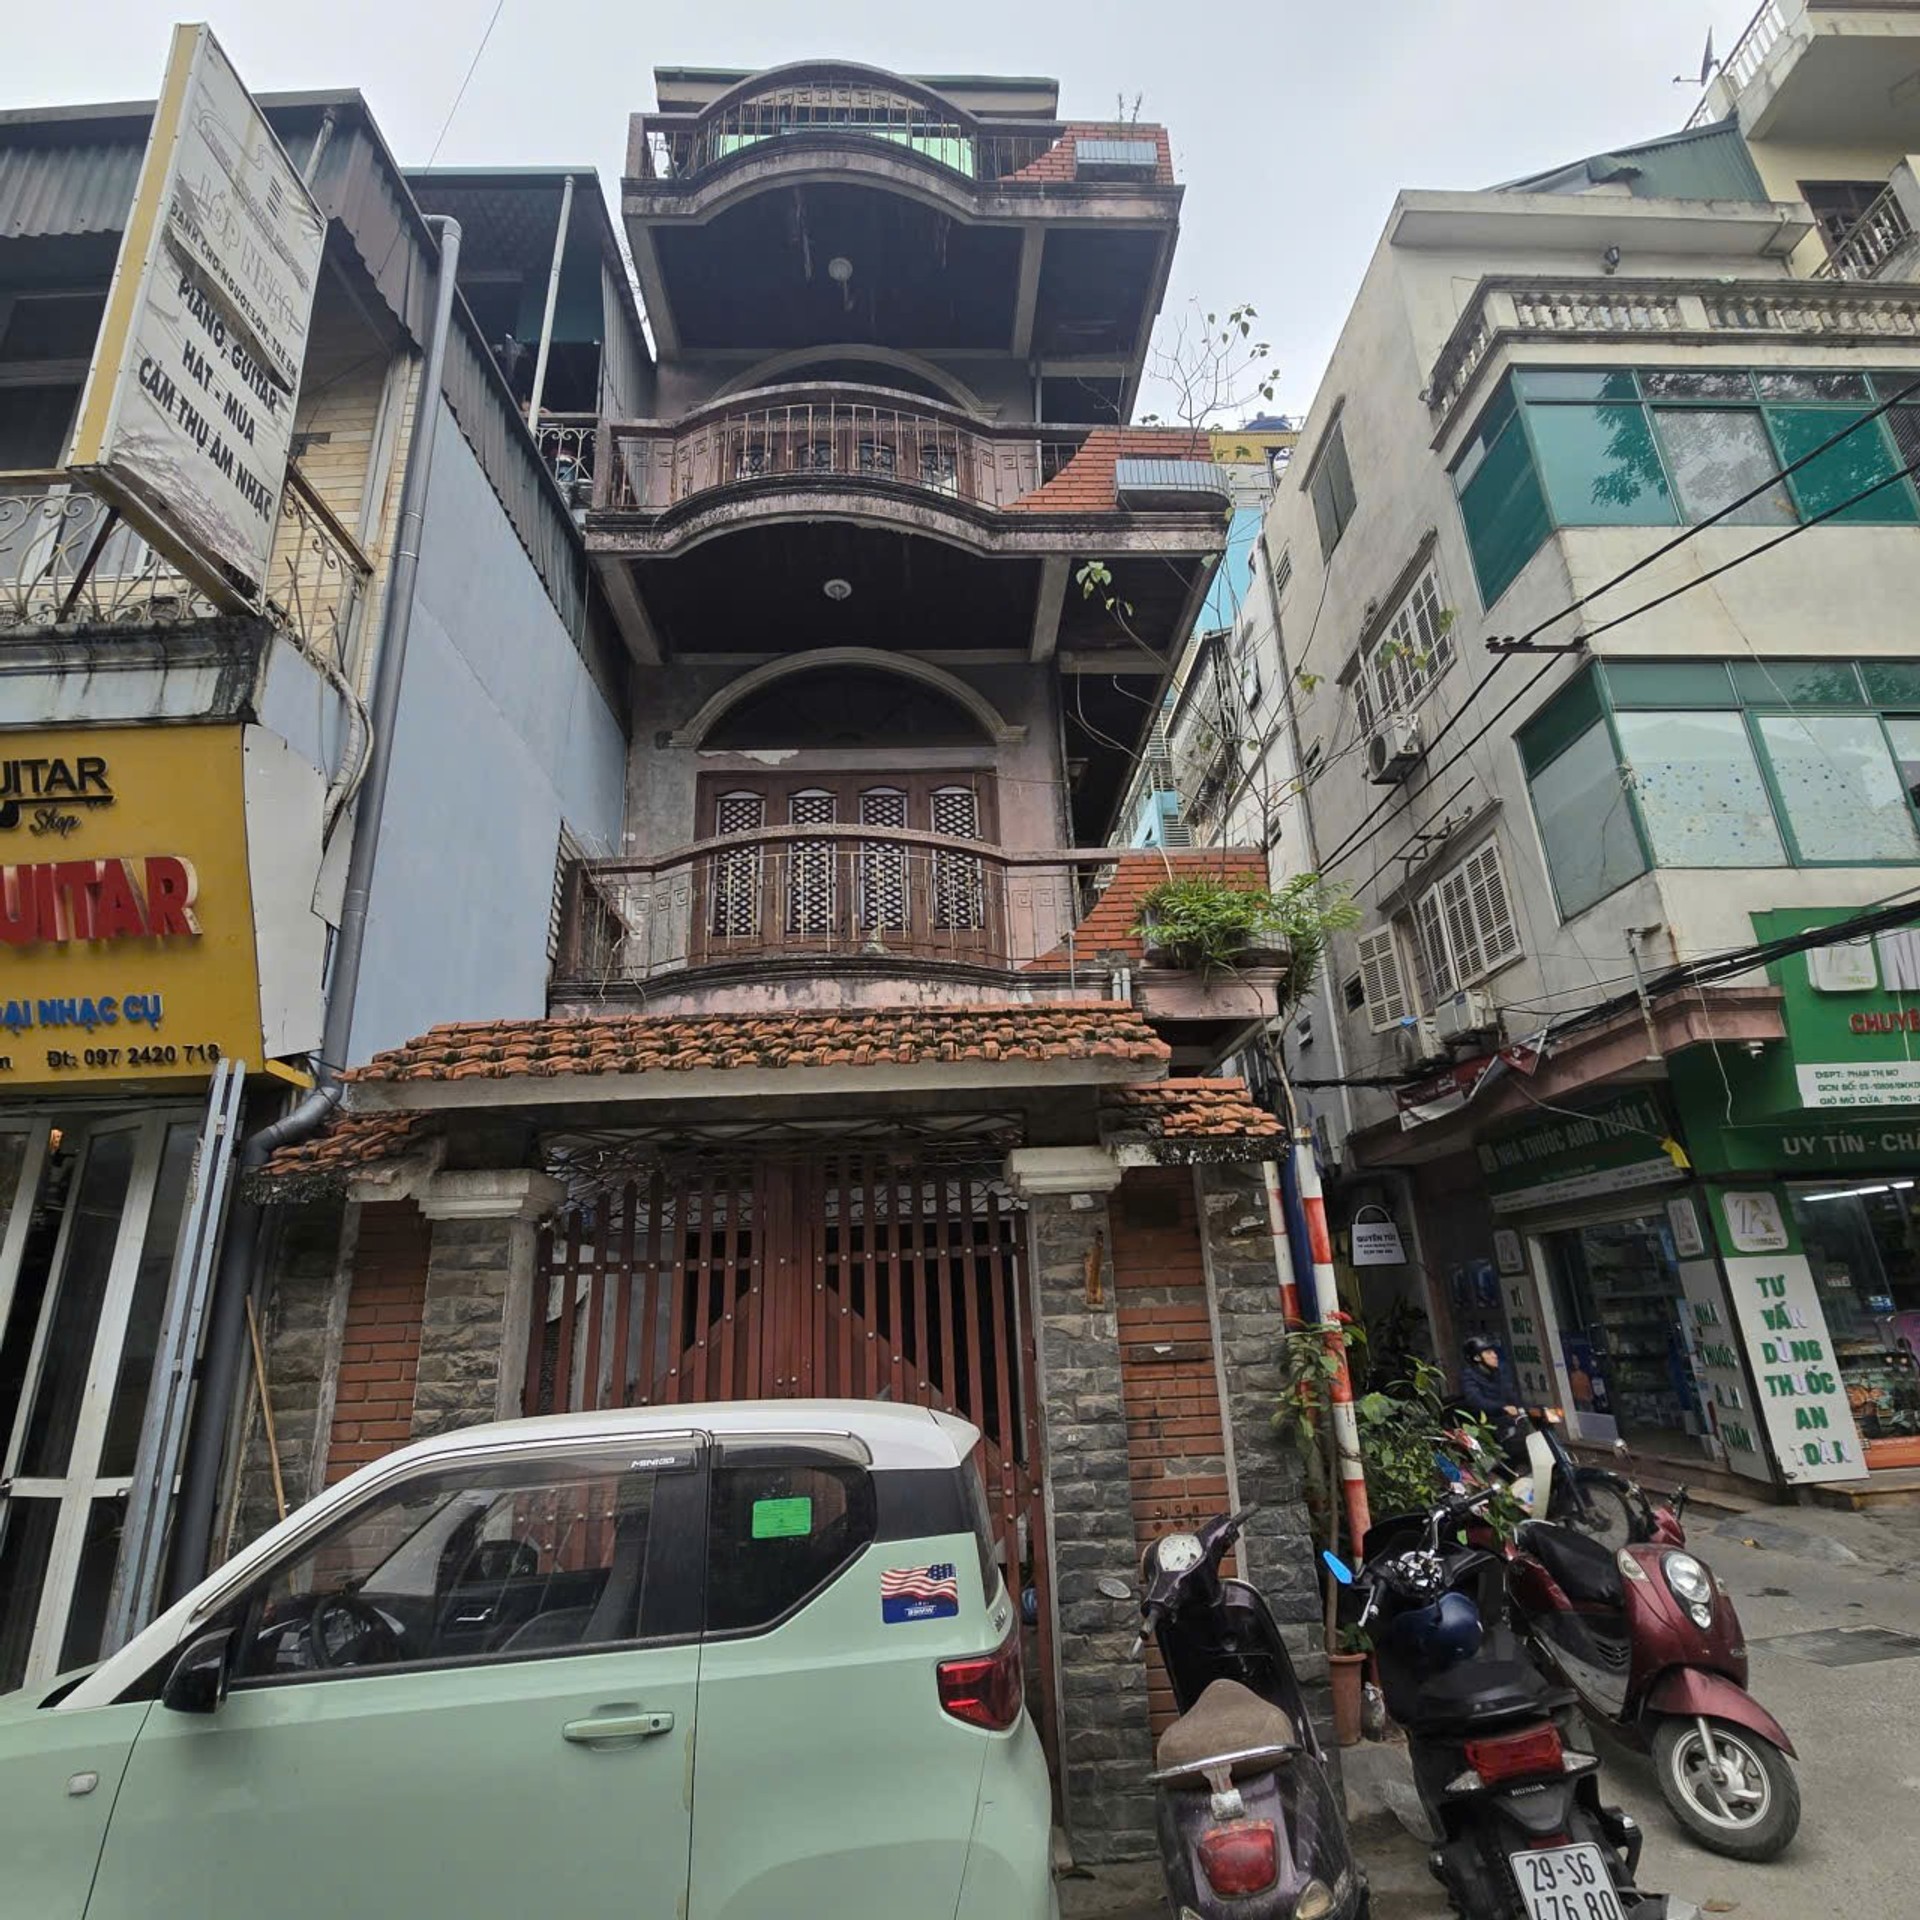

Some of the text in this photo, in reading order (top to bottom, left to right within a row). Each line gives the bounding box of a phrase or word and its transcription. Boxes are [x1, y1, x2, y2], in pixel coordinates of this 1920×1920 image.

[178, 271, 228, 359] PIANO,
[231, 344, 278, 416] GUITAR
[182, 339, 214, 392] HÁT
[223, 391, 255, 446] MÚA
[138, 357, 273, 523] CẢM THỤ ÂM NHẠC
[29, 805, 82, 840] Shop
[0, 993, 164, 1036] ẠI NHẠC CỤ
[46, 1050, 78, 1068] Đt:
[84, 1048, 120, 1066] 097
[127, 1045, 177, 1065] 2420
[182, 1043, 221, 1064] 718
[1783, 1136, 1816, 1156] UY
[1822, 1130, 1866, 1154] TÍN
[1881, 1130, 1920, 1152] CH
[1756, 1274, 1786, 1299] TƯ
[1761, 1300, 1808, 1331] VẤN
[1761, 1336, 1824, 1365] DÙNG
[1764, 1365, 1836, 1397] THUỐC
[1795, 1406, 1829, 1431] AN
[1525, 1852, 1596, 1892] 29-S6
